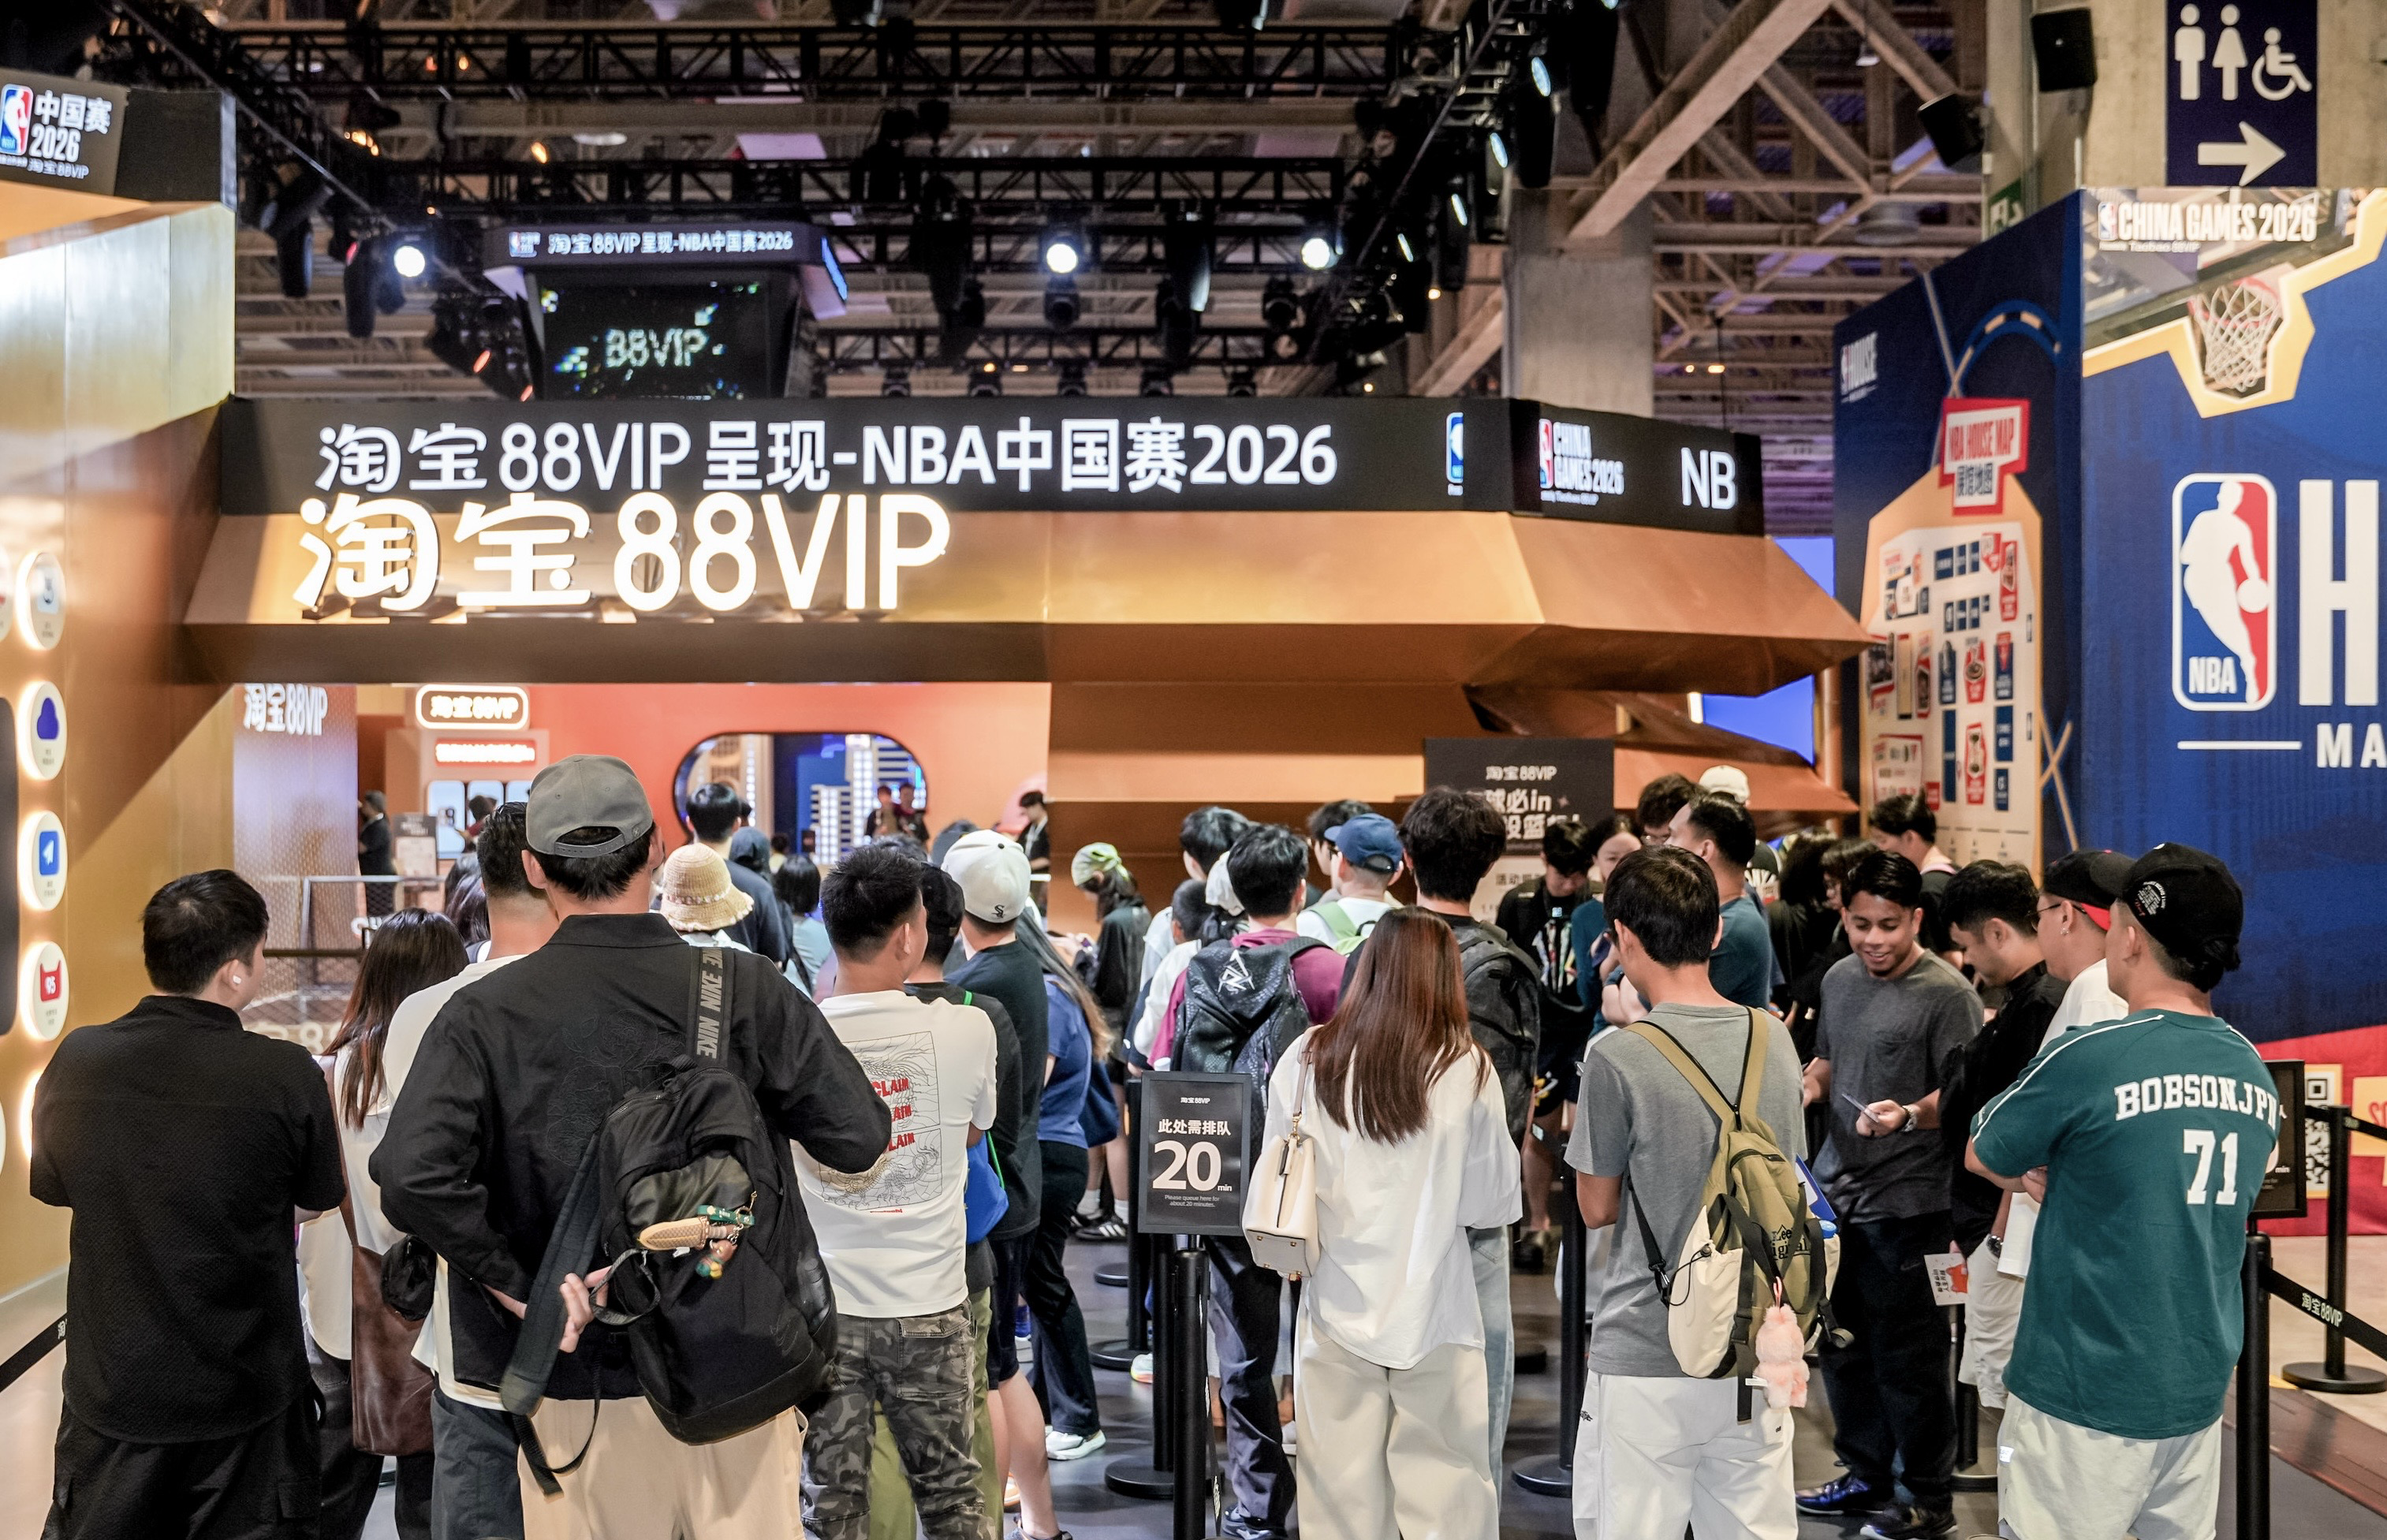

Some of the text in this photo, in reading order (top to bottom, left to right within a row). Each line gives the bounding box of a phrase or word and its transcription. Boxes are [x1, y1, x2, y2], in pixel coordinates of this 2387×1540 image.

[34, 89, 113, 135] 中国赛
[28, 122, 82, 163] 2026
[27, 158, 90, 179] 淘宝88VIP
[2118, 202, 2318, 242] CHINA GAMES 2026
[1553, 421, 1593, 460] CHINA
[1553, 456, 1625, 495] GAMES 2026
[1680, 446, 1736, 510] NB
[293, 491, 951, 612] 淘宝88VIP
[2299, 479, 2379, 707] H
[2188, 656, 2237, 695] NBA
[244, 683, 328, 736] 淘宝88VIP
[430, 695, 520, 720] 淘宝88VIP
[1486, 765, 1557, 781] 淘宝88VIP
[700, 969, 723, 1012] NIKE
[696, 1015, 720, 1059] NIKE
[1158, 1118, 1232, 1136] 此处需排队
[1152, 1139, 1233, 1192] 20 min
[2183, 1128, 2238, 1206] 71
[2301, 1292, 2344, 1328] 淘宝88VIP
